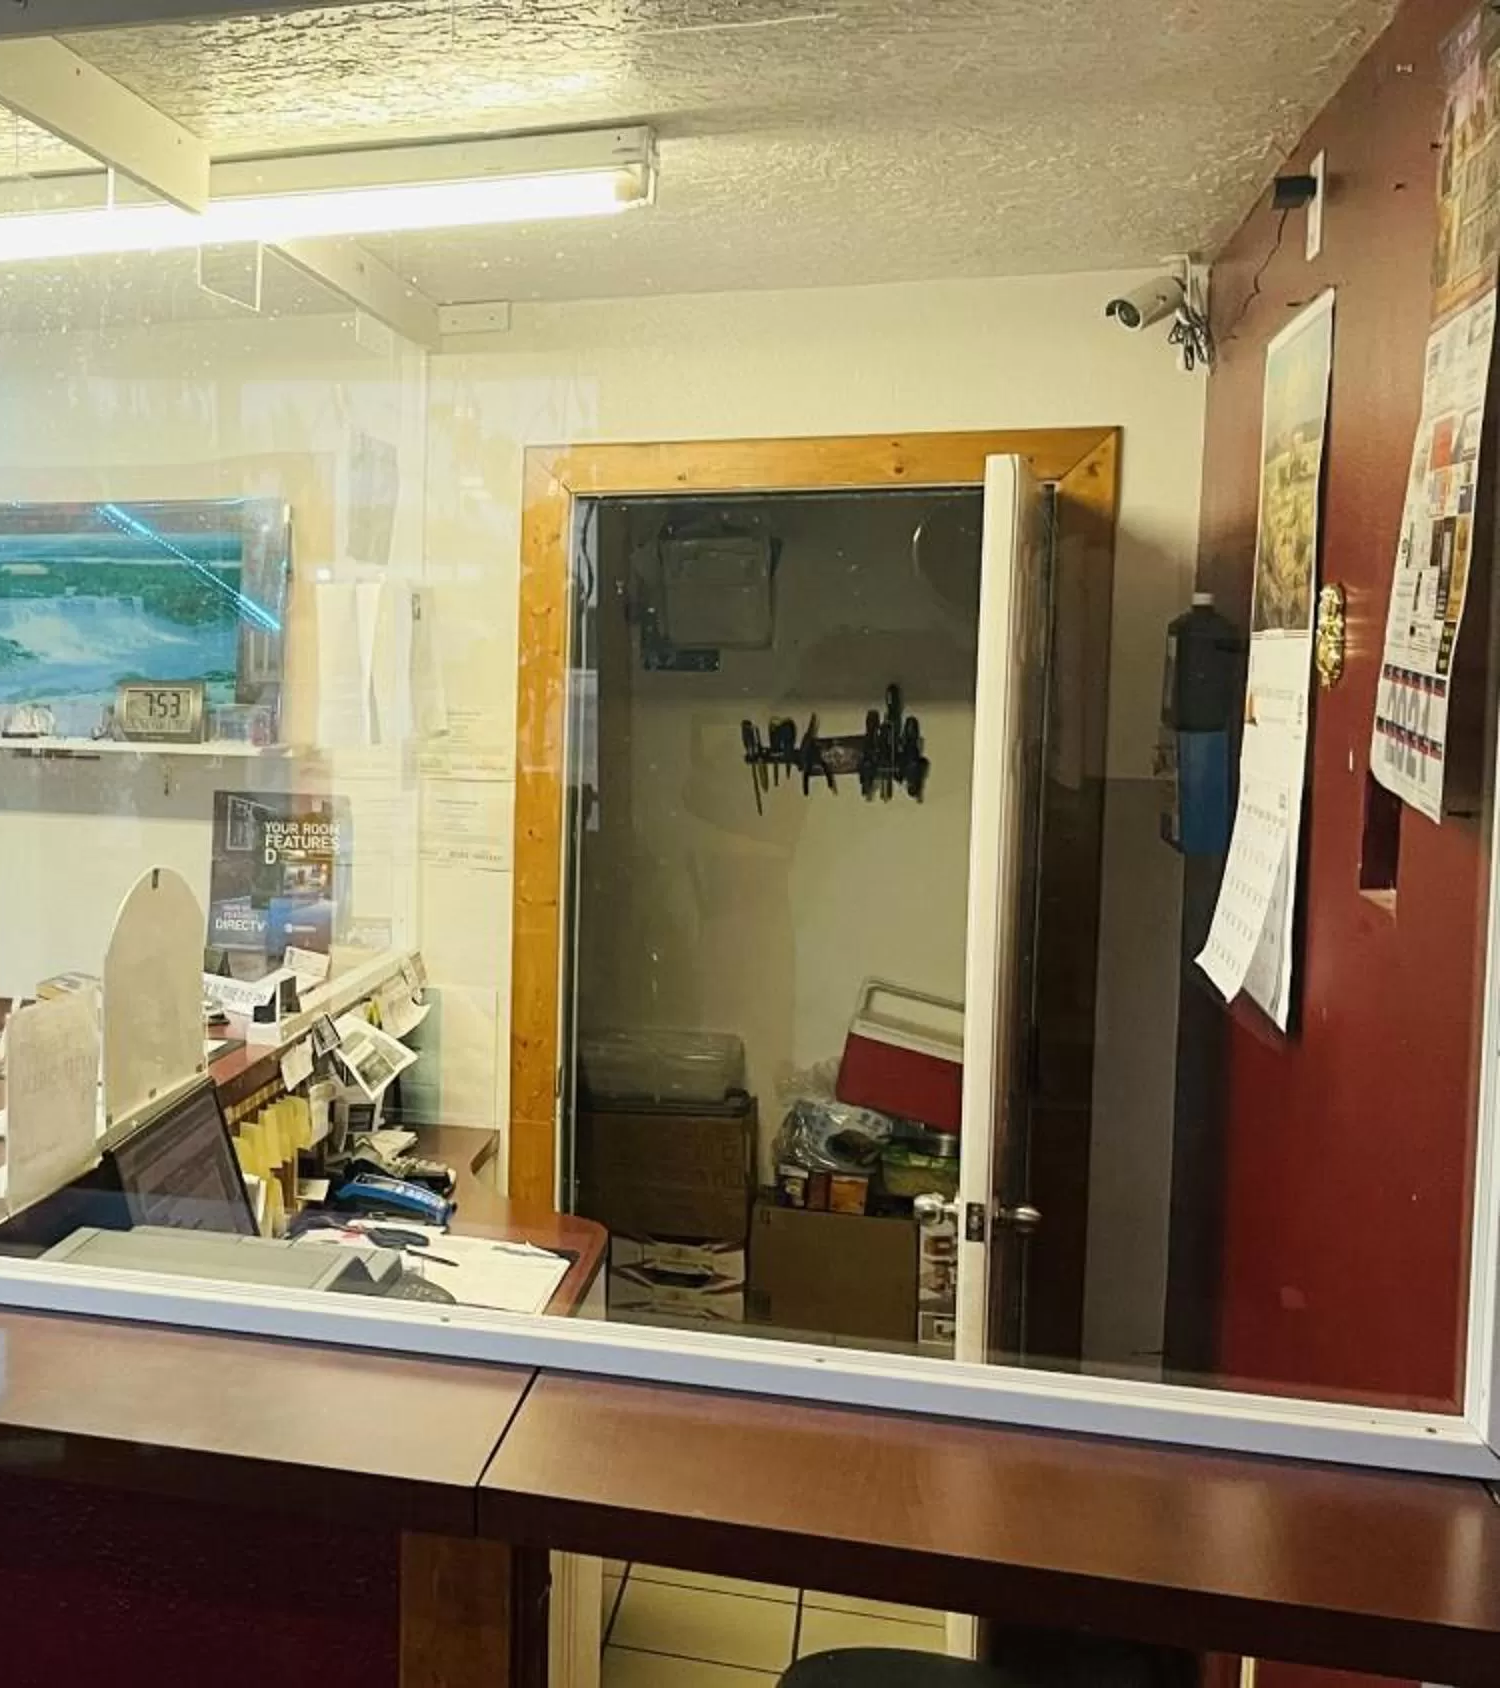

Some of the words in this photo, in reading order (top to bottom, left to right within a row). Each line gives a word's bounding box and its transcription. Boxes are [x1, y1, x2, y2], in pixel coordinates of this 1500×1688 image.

[264, 821, 299, 835] YOUR
[265, 834, 340, 850] FEATURES
[215, 918, 267, 933] DIRECTV
